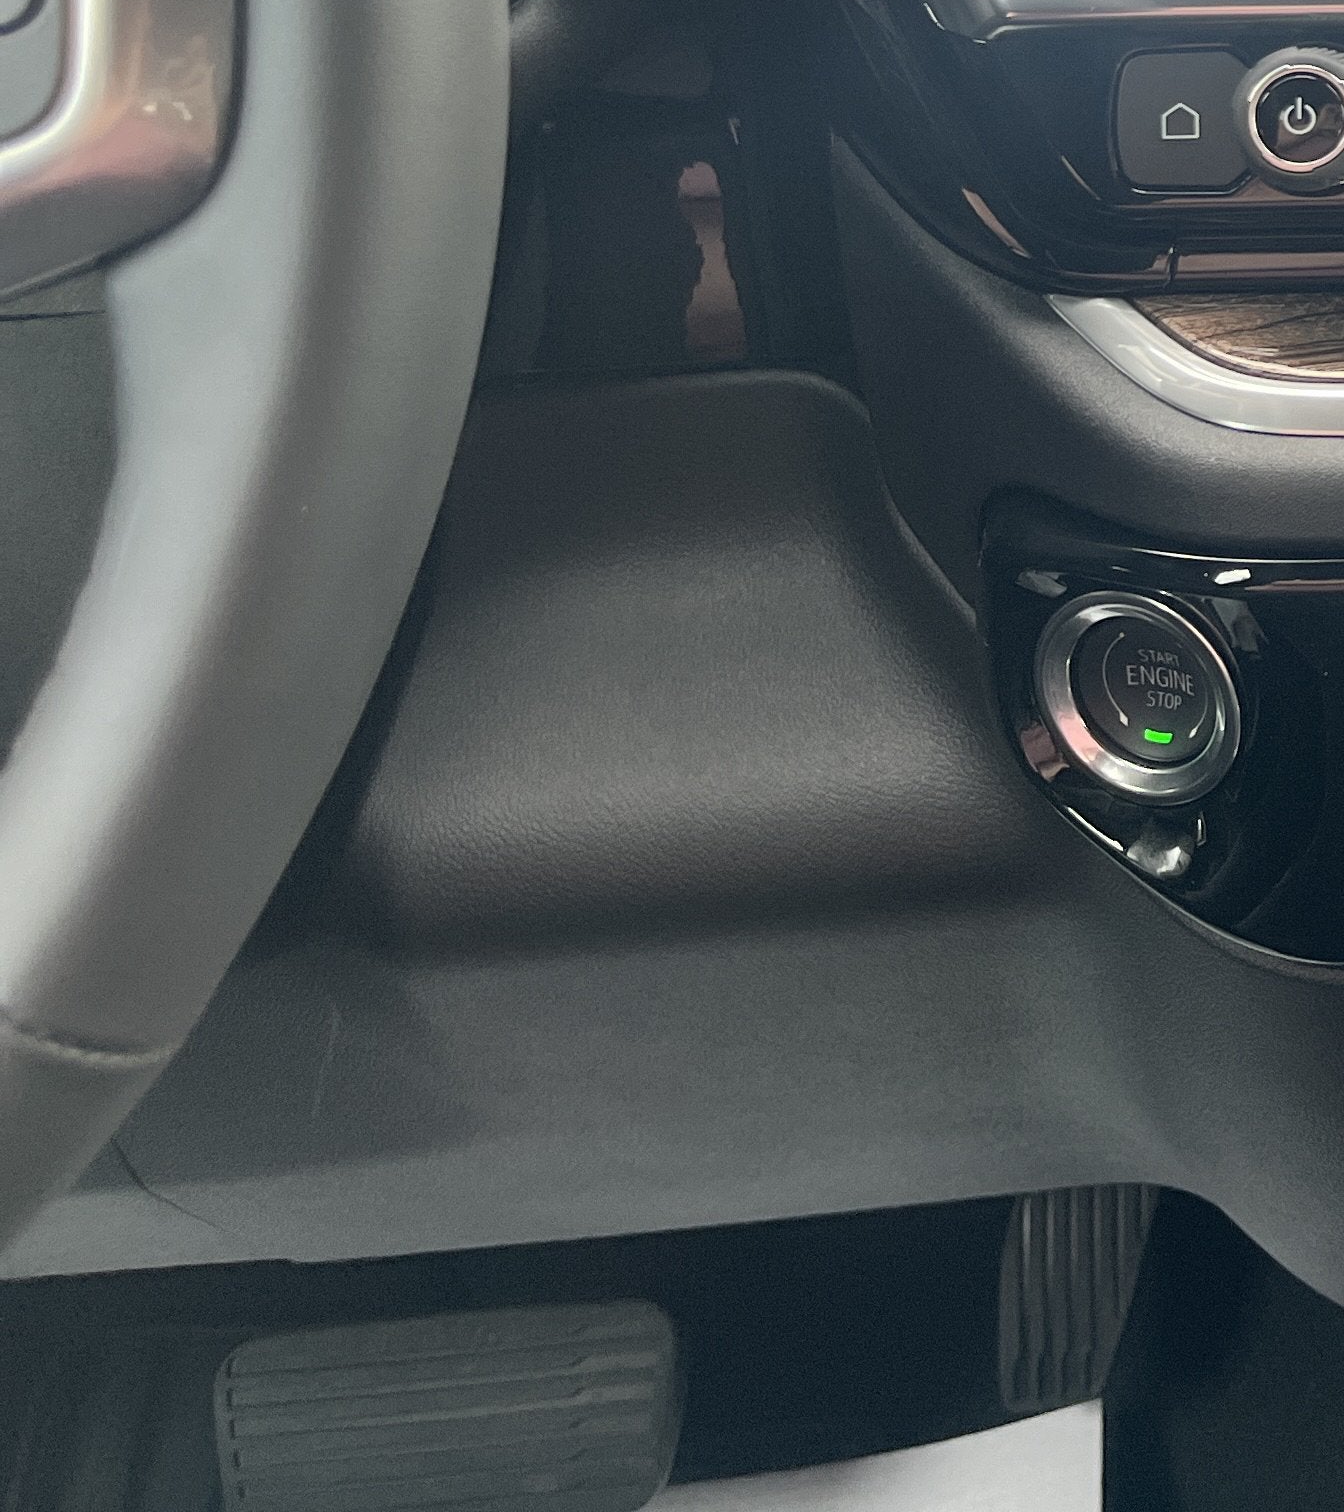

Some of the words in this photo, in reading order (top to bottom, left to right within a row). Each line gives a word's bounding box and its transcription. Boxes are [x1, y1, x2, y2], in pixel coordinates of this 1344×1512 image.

[1137, 648, 1180, 667] START
[1126, 664, 1196, 696] ENGINE
[1146, 691, 1182, 711] STOP
